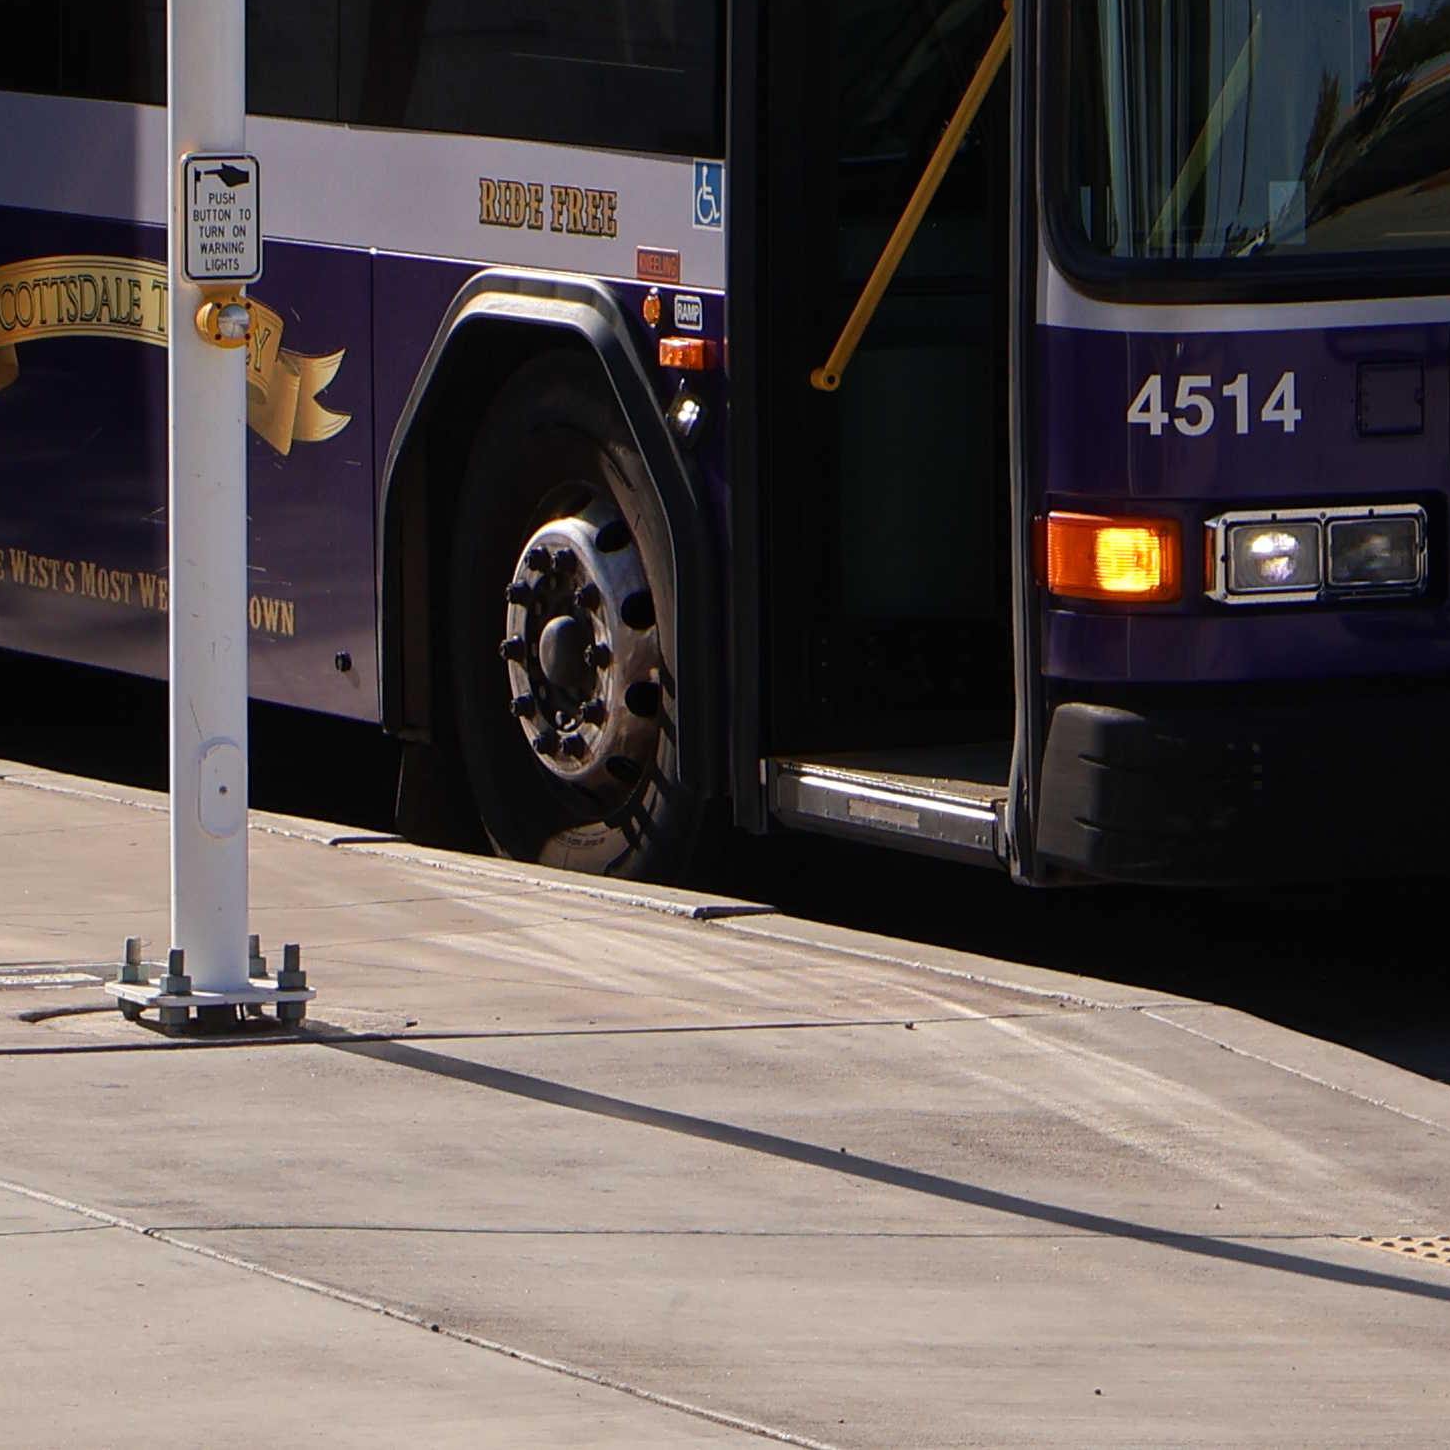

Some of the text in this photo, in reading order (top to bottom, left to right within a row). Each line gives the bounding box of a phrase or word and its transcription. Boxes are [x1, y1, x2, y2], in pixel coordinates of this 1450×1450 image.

[208, 193, 236, 205] PUSH
[479, 178, 617, 238] RIDE FREE
[193, 209, 252, 222] BUTTON TO
[199, 225, 246, 238] TURN ON
[200, 241, 245, 255] WARNING
[205, 258, 240, 271] LIGHTS
[677, 301, 699, 323] RAMP
[1127, 371, 1302, 437] 4514
[80, 560, 133, 606] MOST
[248, 594, 296, 637] OWN
